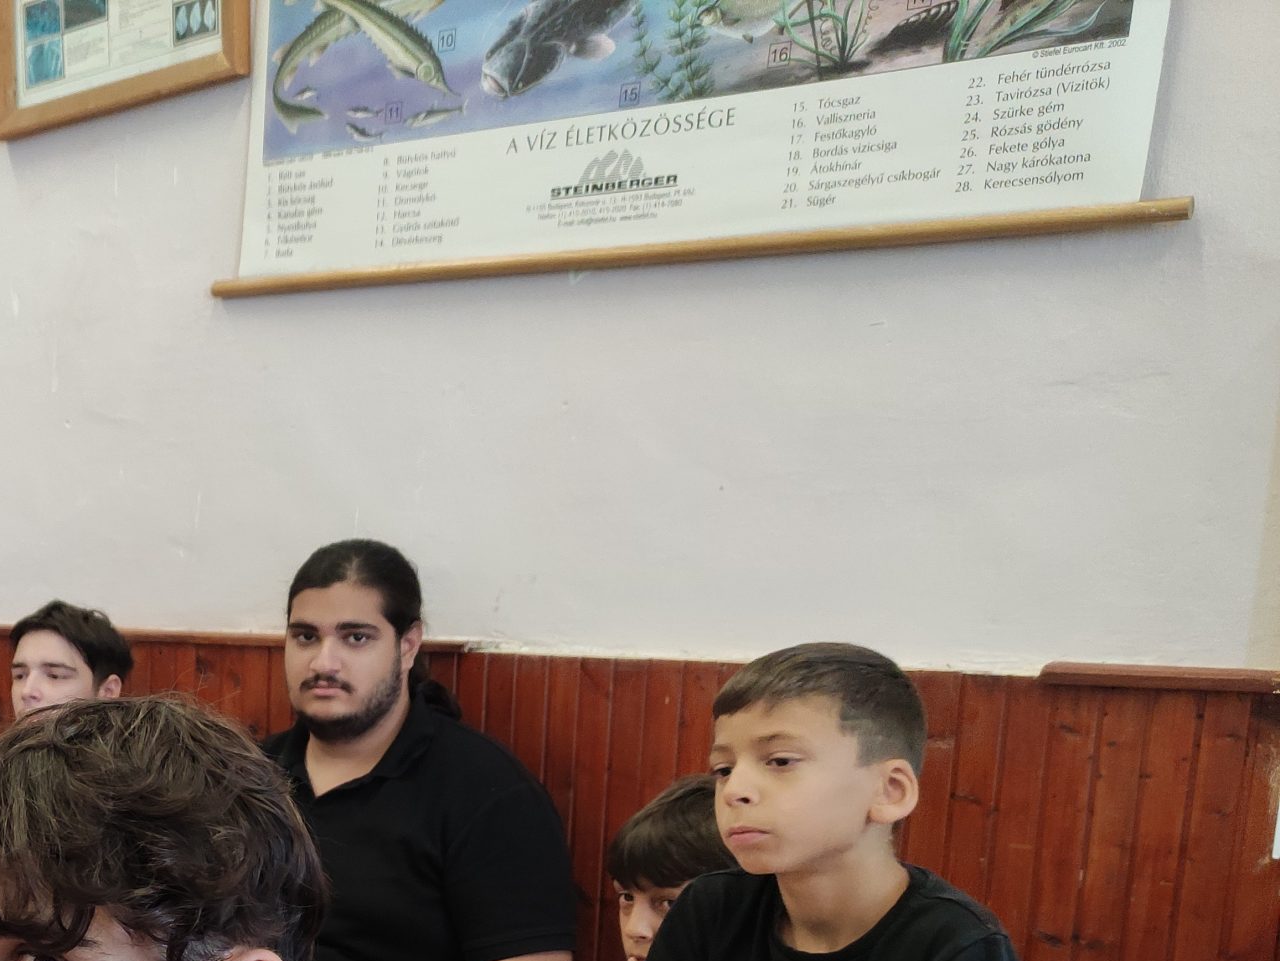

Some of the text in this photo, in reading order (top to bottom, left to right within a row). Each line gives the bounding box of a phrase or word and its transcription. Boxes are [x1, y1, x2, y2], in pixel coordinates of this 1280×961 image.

[440, 32, 454, 48] 10
[1040, 47, 1062, 58] Stiefel
[1063, 43, 1093, 55] Eurocart
[1107, 39, 1127, 49] 2002
[771, 46, 789, 63] 16
[967, 60, 1111, 90] 22. Fehér tündérrózsa
[622, 86, 639, 101] 15
[966, 77, 1110, 107] 23. Tavirózsa (Vizitök)
[388, 106, 401, 120] 11
[793, 95, 861, 113] 15. Tócsgaz
[964, 101, 1065, 125] 24. Szürke gém
[791, 109, 876, 129] 16. Valliszneria
[961, 117, 1084, 142] 25. Rózsás gödény
[506, 106, 737, 155] A VÍZ ÉLETKÖZÖSSÉGE
[789, 124, 877, 145] 17. Festőkagyló
[788, 150, 803, 161] 18.
[812, 144, 849, 160] Bordás
[959, 136, 1065, 159] 26. Fekete gólya
[786, 159, 862, 178] 19. Átokhínár
[957, 151, 1091, 176] 27. Nagy kárókatona
[550, 173, 678, 198] STEINBERGER
[783, 167, 942, 194] 20. Sárgaszegélyű csíkbogár
[954, 169, 1085, 193] 28. Kerecsensólyom
[781, 198, 797, 210] 21.
